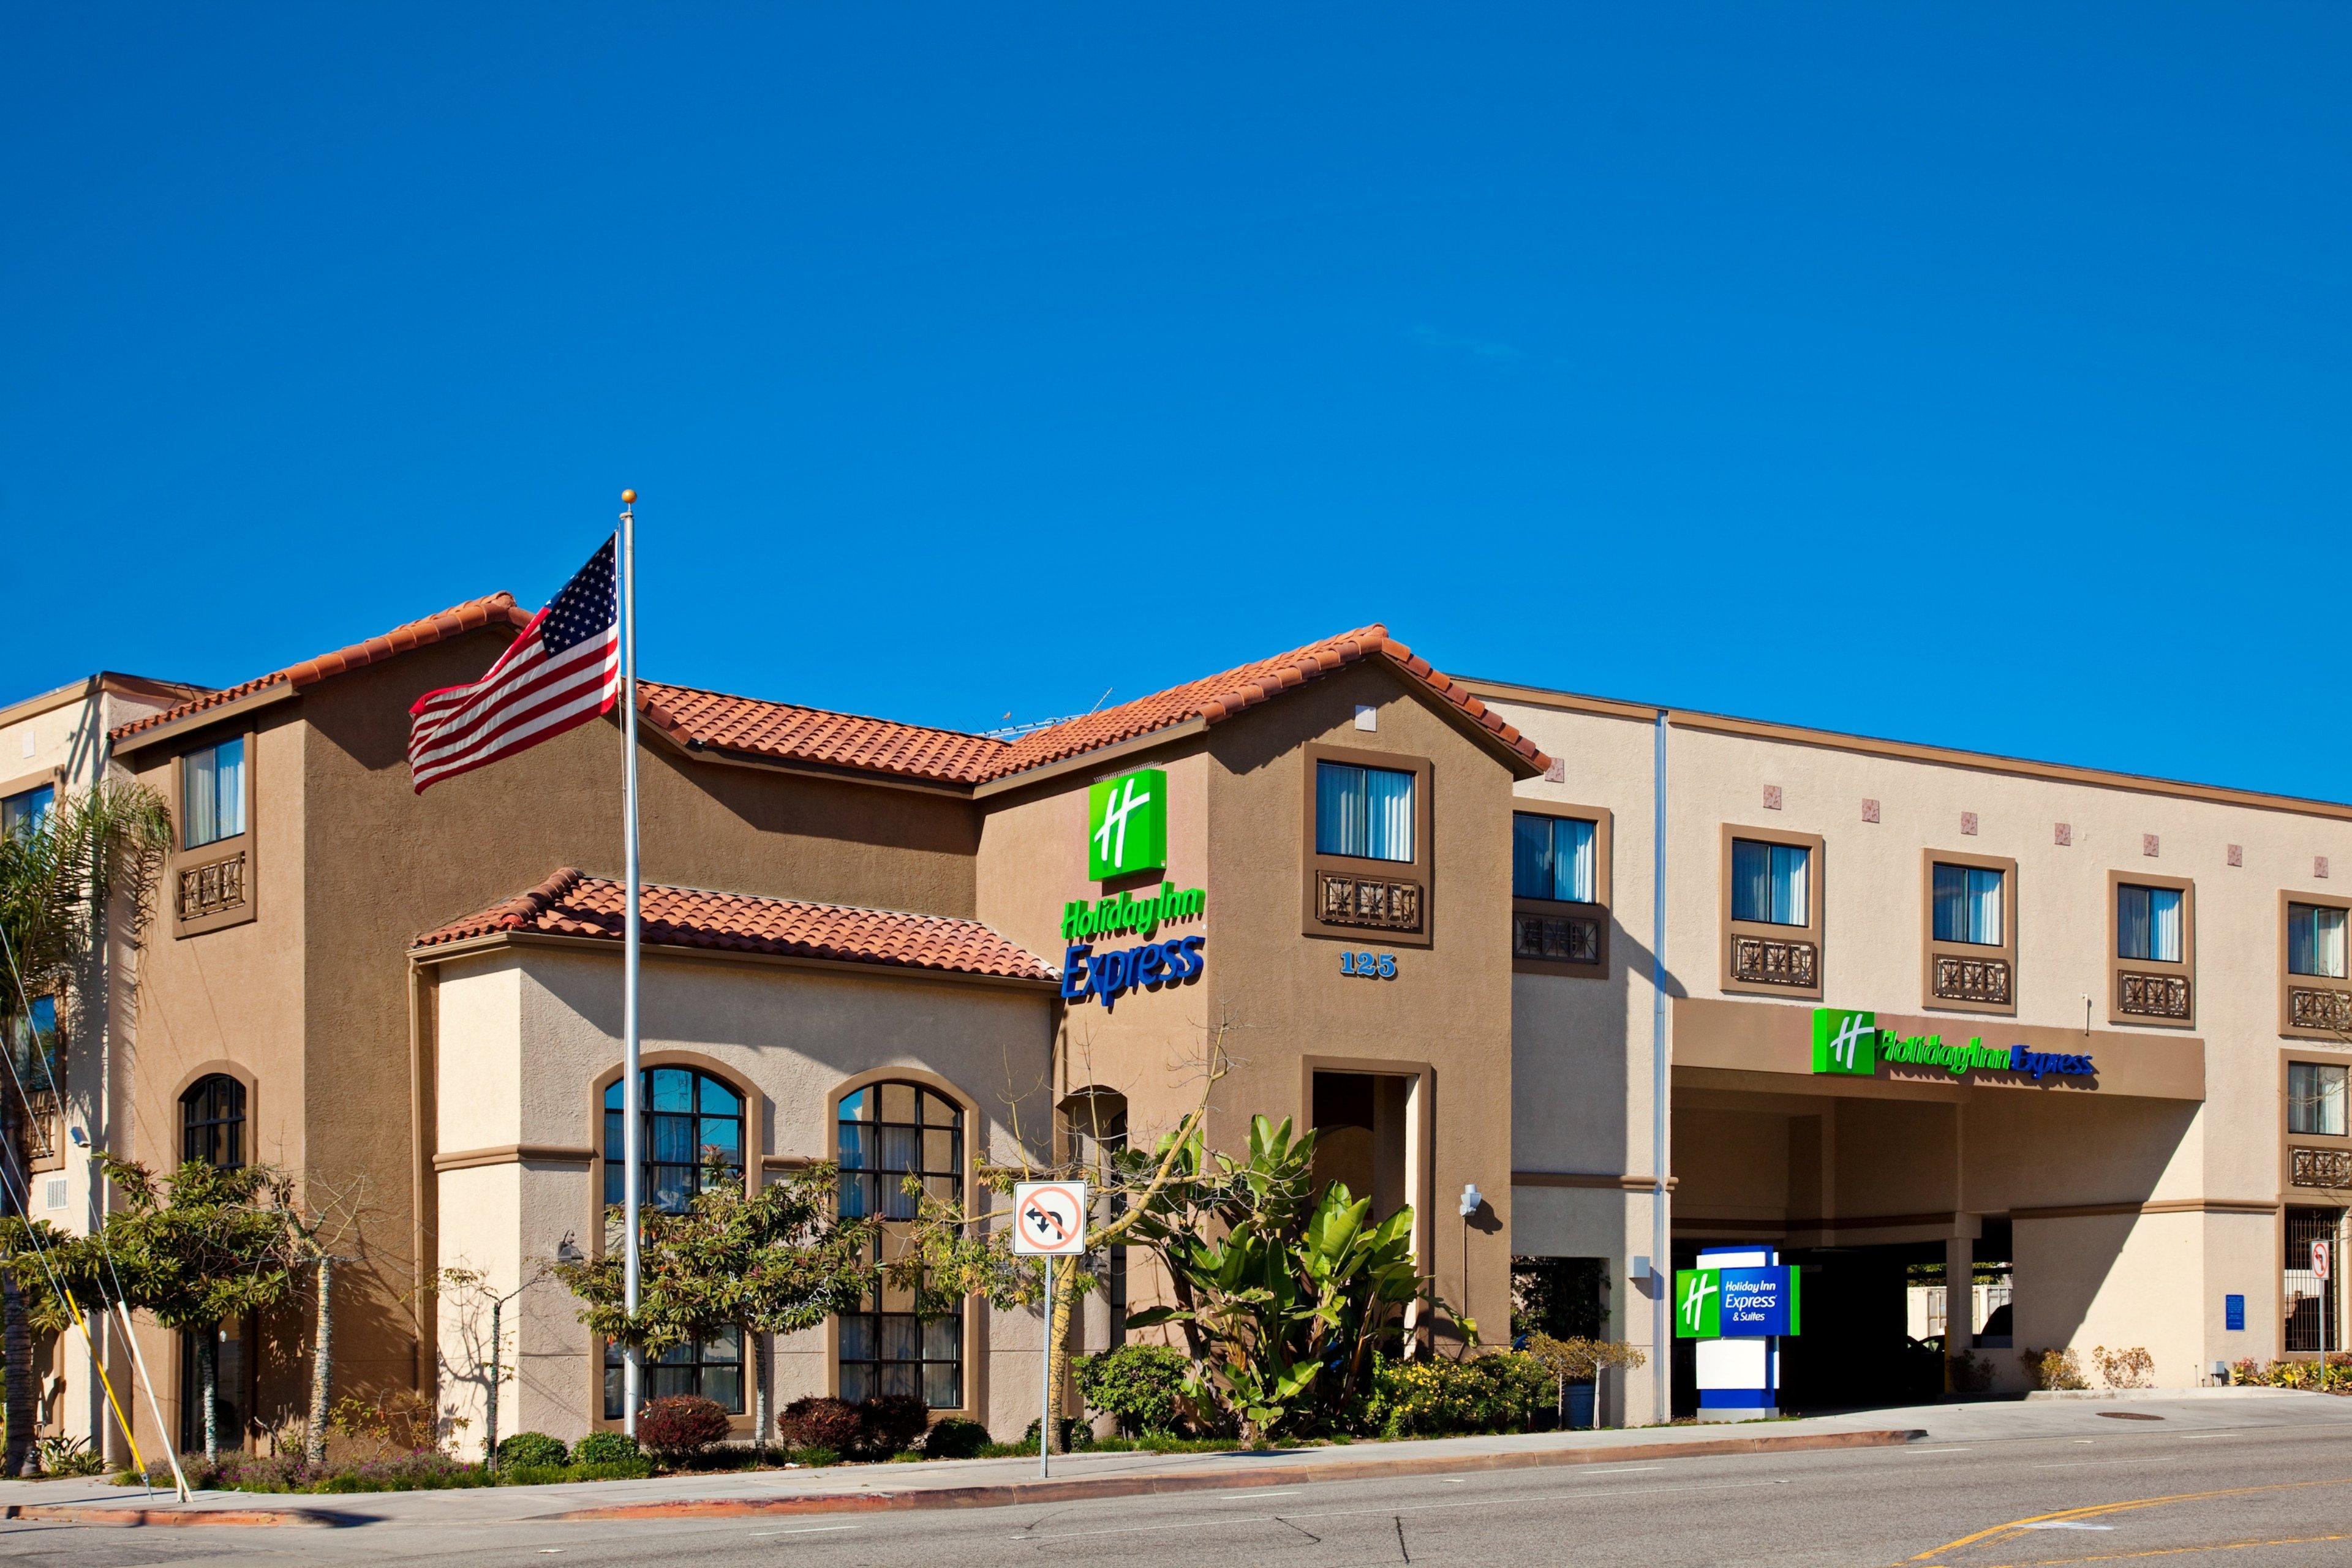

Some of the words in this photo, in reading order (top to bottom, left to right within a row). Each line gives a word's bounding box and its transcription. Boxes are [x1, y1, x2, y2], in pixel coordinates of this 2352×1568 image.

[1060, 891, 1160, 939] Holiday
[1158, 881, 1205, 919] Inn
[1061, 935, 1205, 1006] Express
[1341, 951, 1396, 977] 125
[1875, 1028, 1969, 1074] Holiday
[1968, 1036, 2010, 1069] Inn
[2010, 1045, 2093, 1079] Express
[1725, 1281, 1760, 1293] Holiday
[1760, 1280, 1776, 1291] Inn
[1725, 1294, 1776, 1311] Express
[1733, 1312, 1740, 1321] &
[1740, 1311, 1765, 1321] Suites
